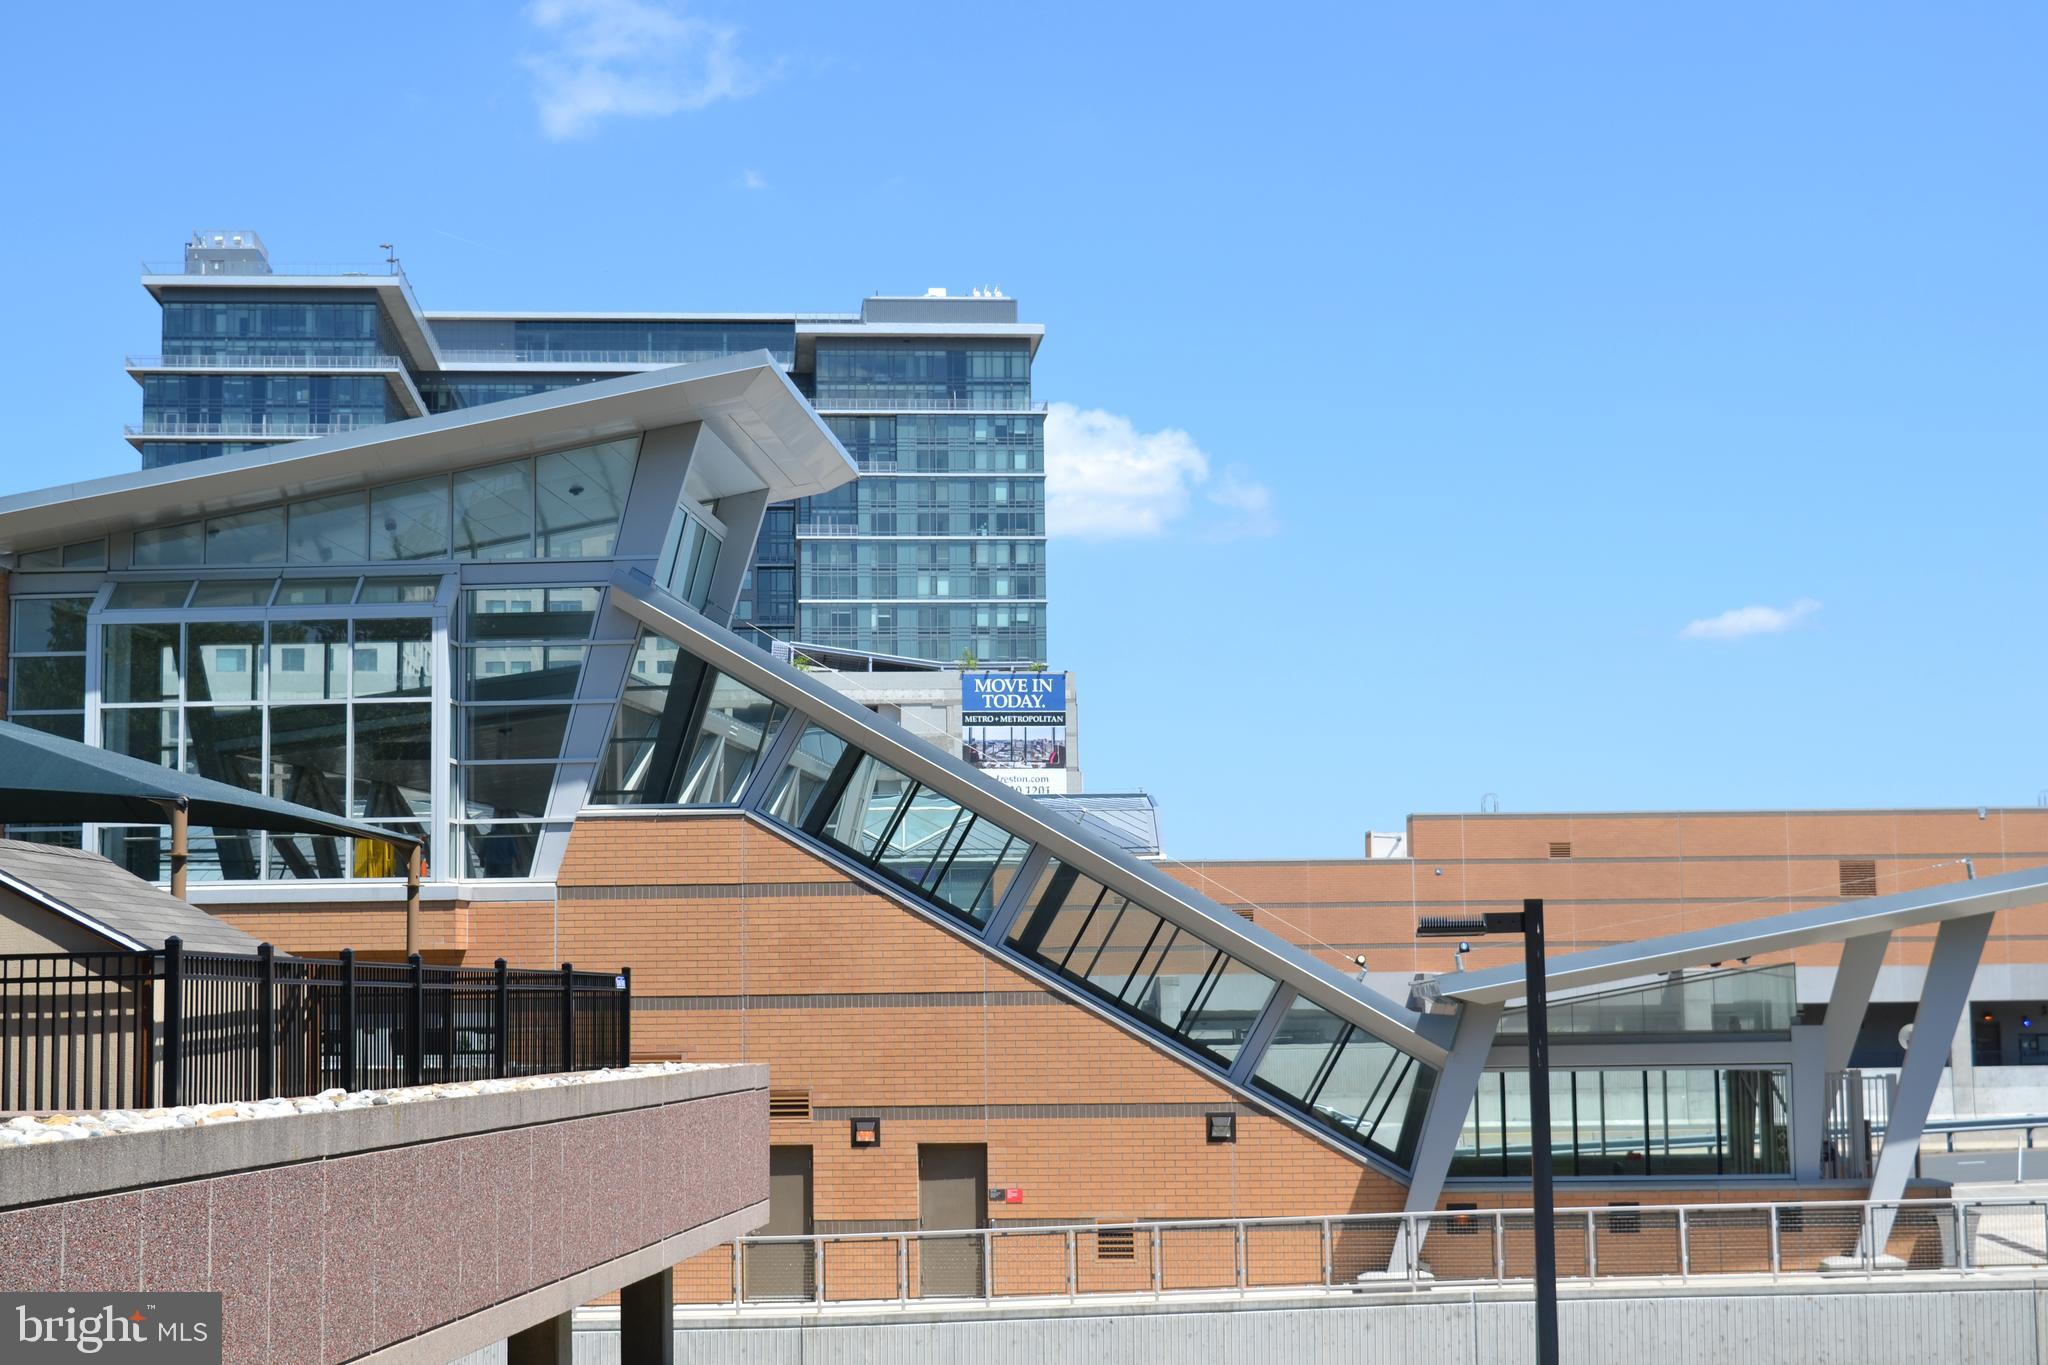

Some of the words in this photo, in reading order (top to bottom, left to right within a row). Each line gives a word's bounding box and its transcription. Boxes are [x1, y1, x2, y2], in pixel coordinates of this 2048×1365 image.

[974, 678, 1028, 693] MOVE
[1032, 678, 1053, 693] IN
[982, 694, 1046, 709] TODAY.
[964, 715, 994, 723] METRO
[1000, 715, 1064, 723] METROPOLITAN
